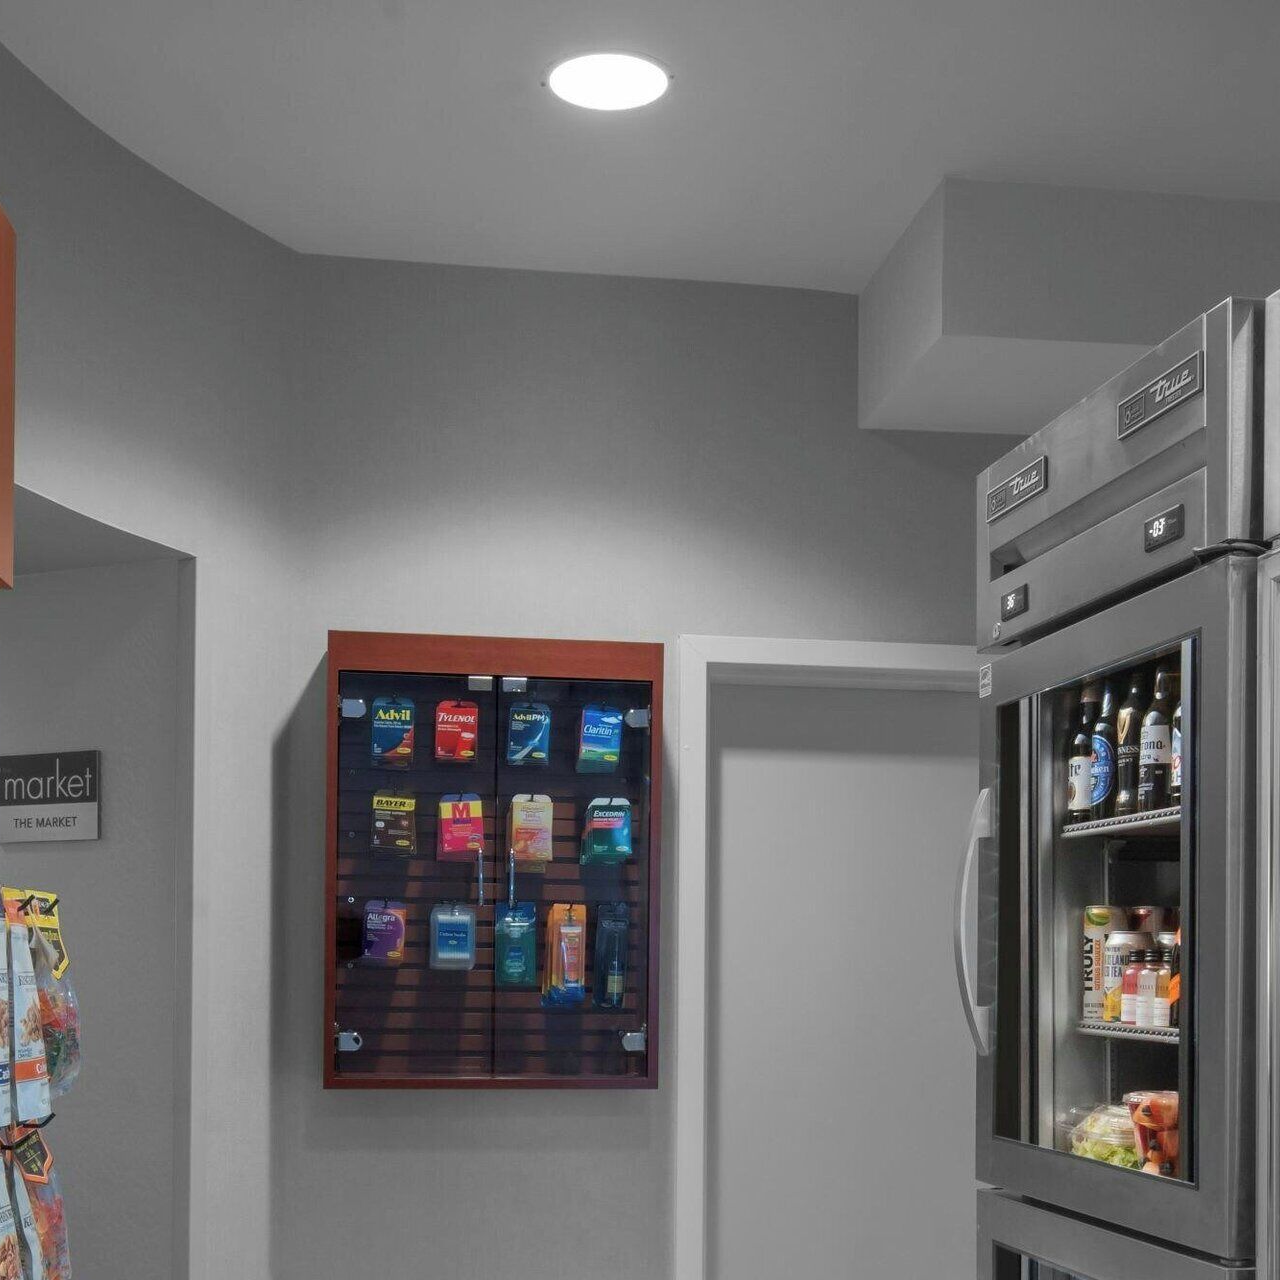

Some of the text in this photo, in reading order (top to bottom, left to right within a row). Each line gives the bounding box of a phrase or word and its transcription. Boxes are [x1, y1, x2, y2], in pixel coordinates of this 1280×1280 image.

[374, 708, 412, 721] Advil
[437, 711, 476, 724] TYLENOL
[583, 723, 614, 737] Claritin
[4, 758, 92, 801] market
[375, 799, 407, 808] BAYER
[13, 815, 78, 829] THE MARKET
[367, 912, 396, 923] Allegra
[1083, 934, 1094, 992] TRULY
